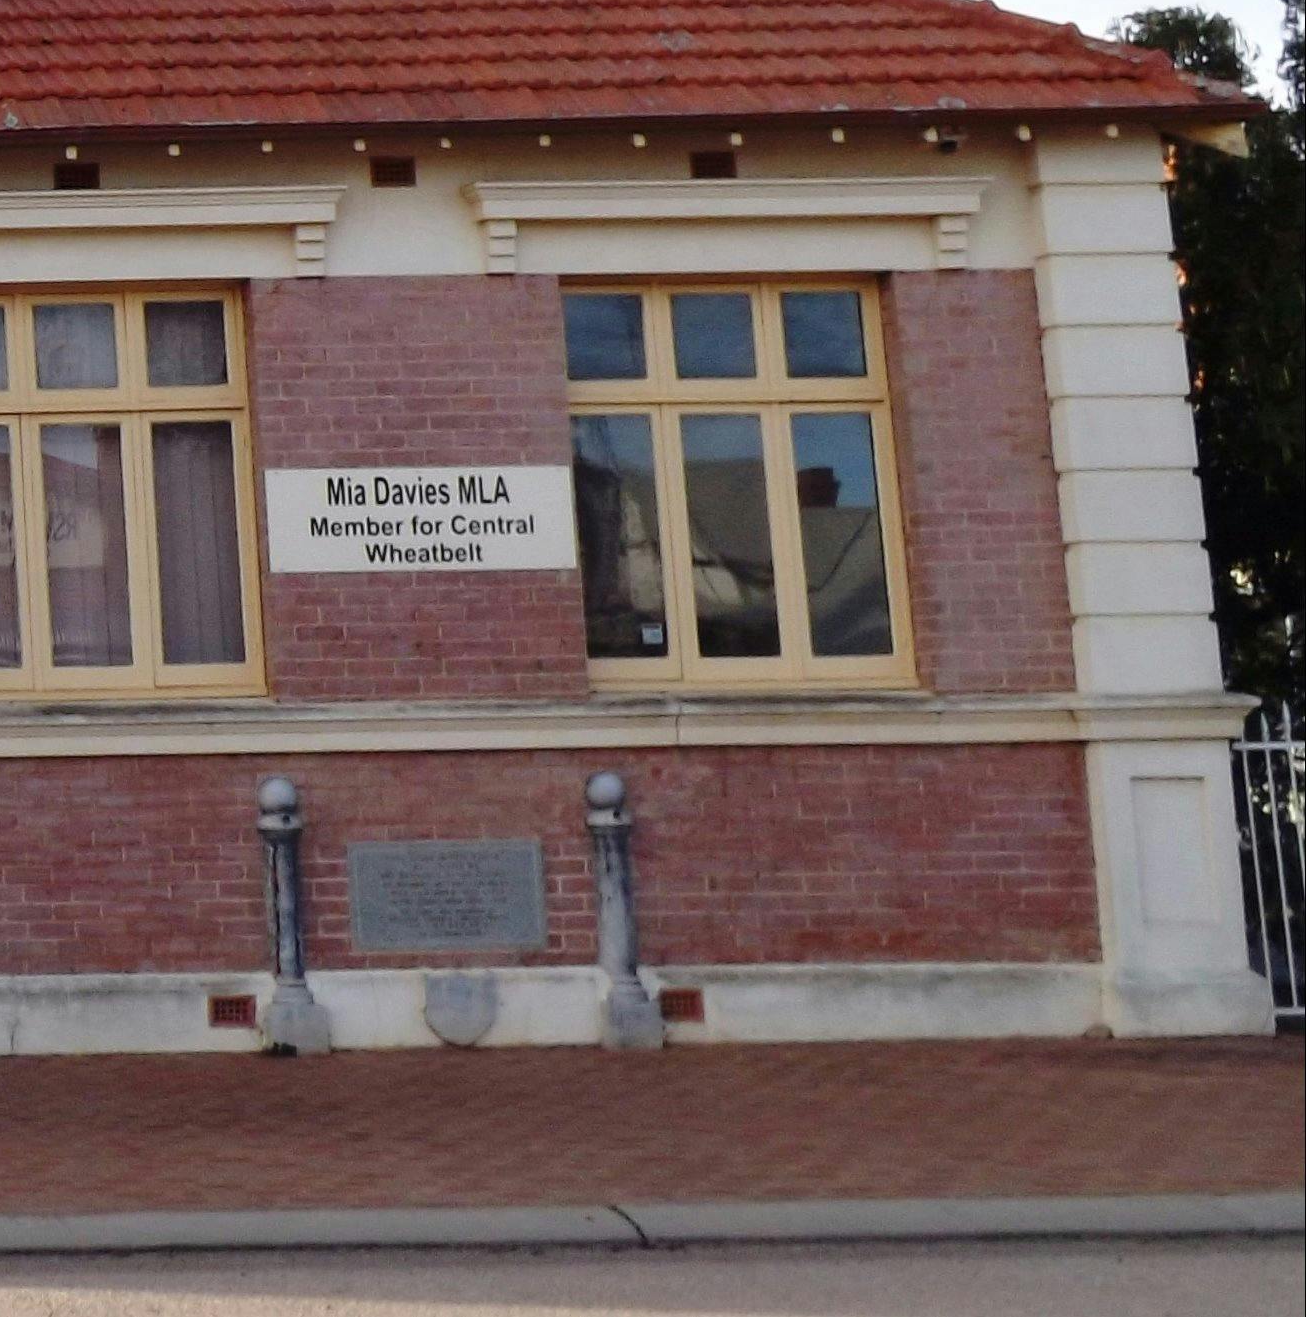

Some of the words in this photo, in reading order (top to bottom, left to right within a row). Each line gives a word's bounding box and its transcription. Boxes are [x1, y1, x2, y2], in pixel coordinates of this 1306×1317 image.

[327, 477, 366, 506] Mia
[374, 476, 450, 506] Davies
[458, 475, 510, 504] MLA
[309, 516, 403, 537] Member
[411, 515, 443, 535] for
[451, 514, 535, 535] Central
[365, 543, 483, 563] Wheatbelt
